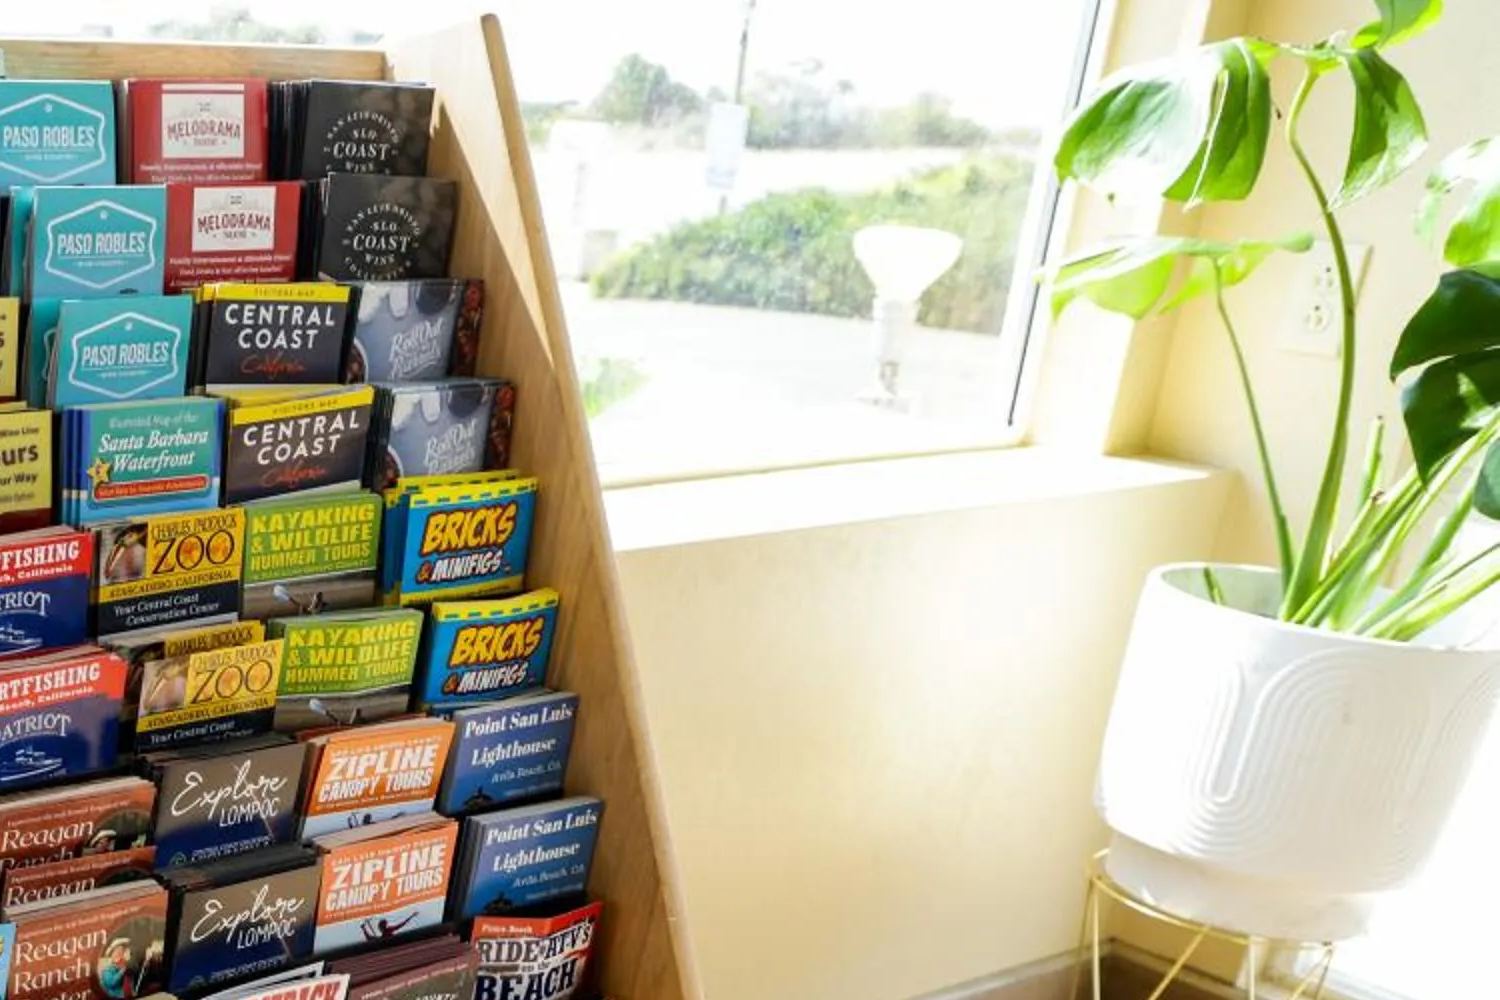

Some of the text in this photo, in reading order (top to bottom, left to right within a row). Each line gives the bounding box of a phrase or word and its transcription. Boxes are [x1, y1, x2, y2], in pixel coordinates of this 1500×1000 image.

[3, 126, 95, 148] PASO ROBLES
[167, 119, 241, 142] MELODRAMA
[333, 141, 391, 161] COAST
[197, 213, 271, 236] MELODRAMA
[57, 231, 147, 255] PASO ROBLES
[224, 303, 336, 326] CENTRAL
[238, 329, 319, 349] COAST
[98, 429, 209, 454] Santa Barbara
[243, 410, 360, 445] CENTRAL
[109, 450, 197, 474] Waterfront
[257, 434, 342, 466] COAST
[251, 503, 376, 535] KAYAKING
[421, 503, 517, 555] BRICKS
[152, 529, 235, 575] ZOO
[289, 619, 416, 651] KAYAKING
[451, 617, 546, 666] BRICKS
[190, 659, 273, 704] ZOO
[465, 702, 575, 738] Point San Luis
[330, 747, 438, 782] ZIPLINE
[171, 759, 289, 820] Explore
[320, 767, 434, 804] CANOPY TOURS
[1, 820, 95, 855] Reagan
[485, 808, 598, 846] Point San Luis
[332, 844, 447, 890] ZIPLINE
[326, 867, 445, 911] CANOPY TOURS
[190, 885, 305, 945] Explore
[15, 928, 108, 967] Reagan
[478, 938, 541, 964] RIDE
[12, 962, 92, 996] Ranch
